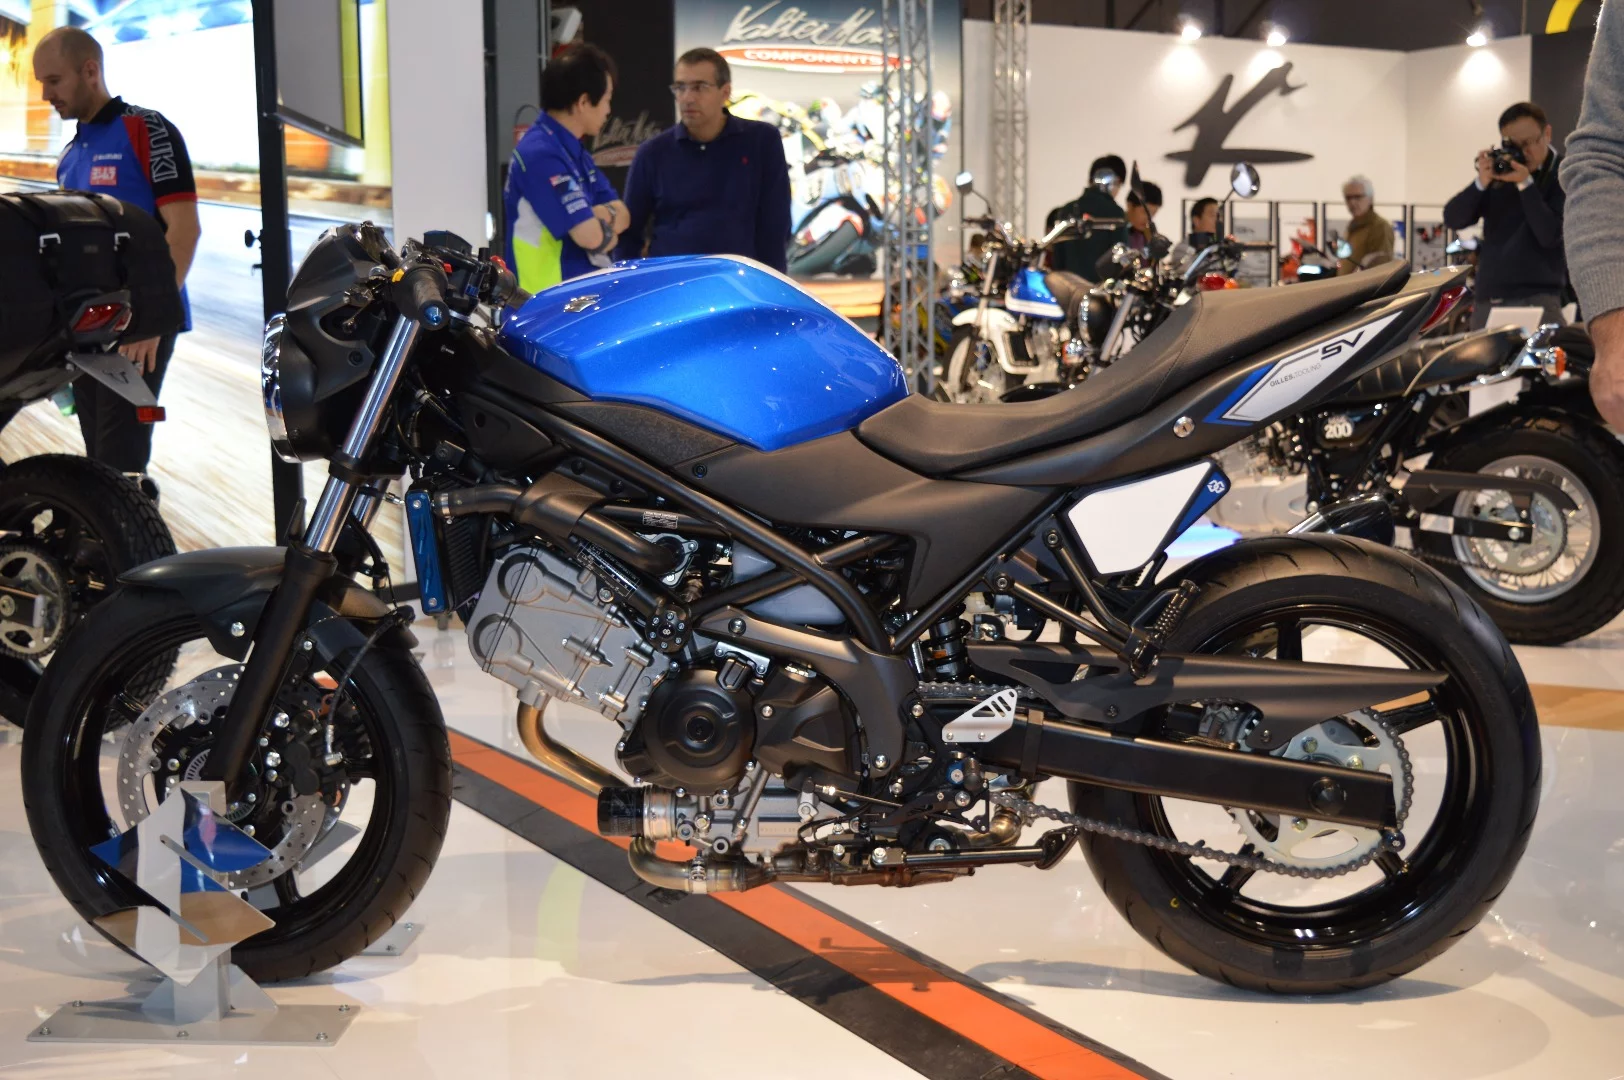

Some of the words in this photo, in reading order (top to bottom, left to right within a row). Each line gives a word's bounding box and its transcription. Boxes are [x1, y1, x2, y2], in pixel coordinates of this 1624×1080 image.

[744, 50, 883, 66] COMPONENTS
[1321, 330, 1365, 360] SV
[1324, 422, 1353, 439] 200
